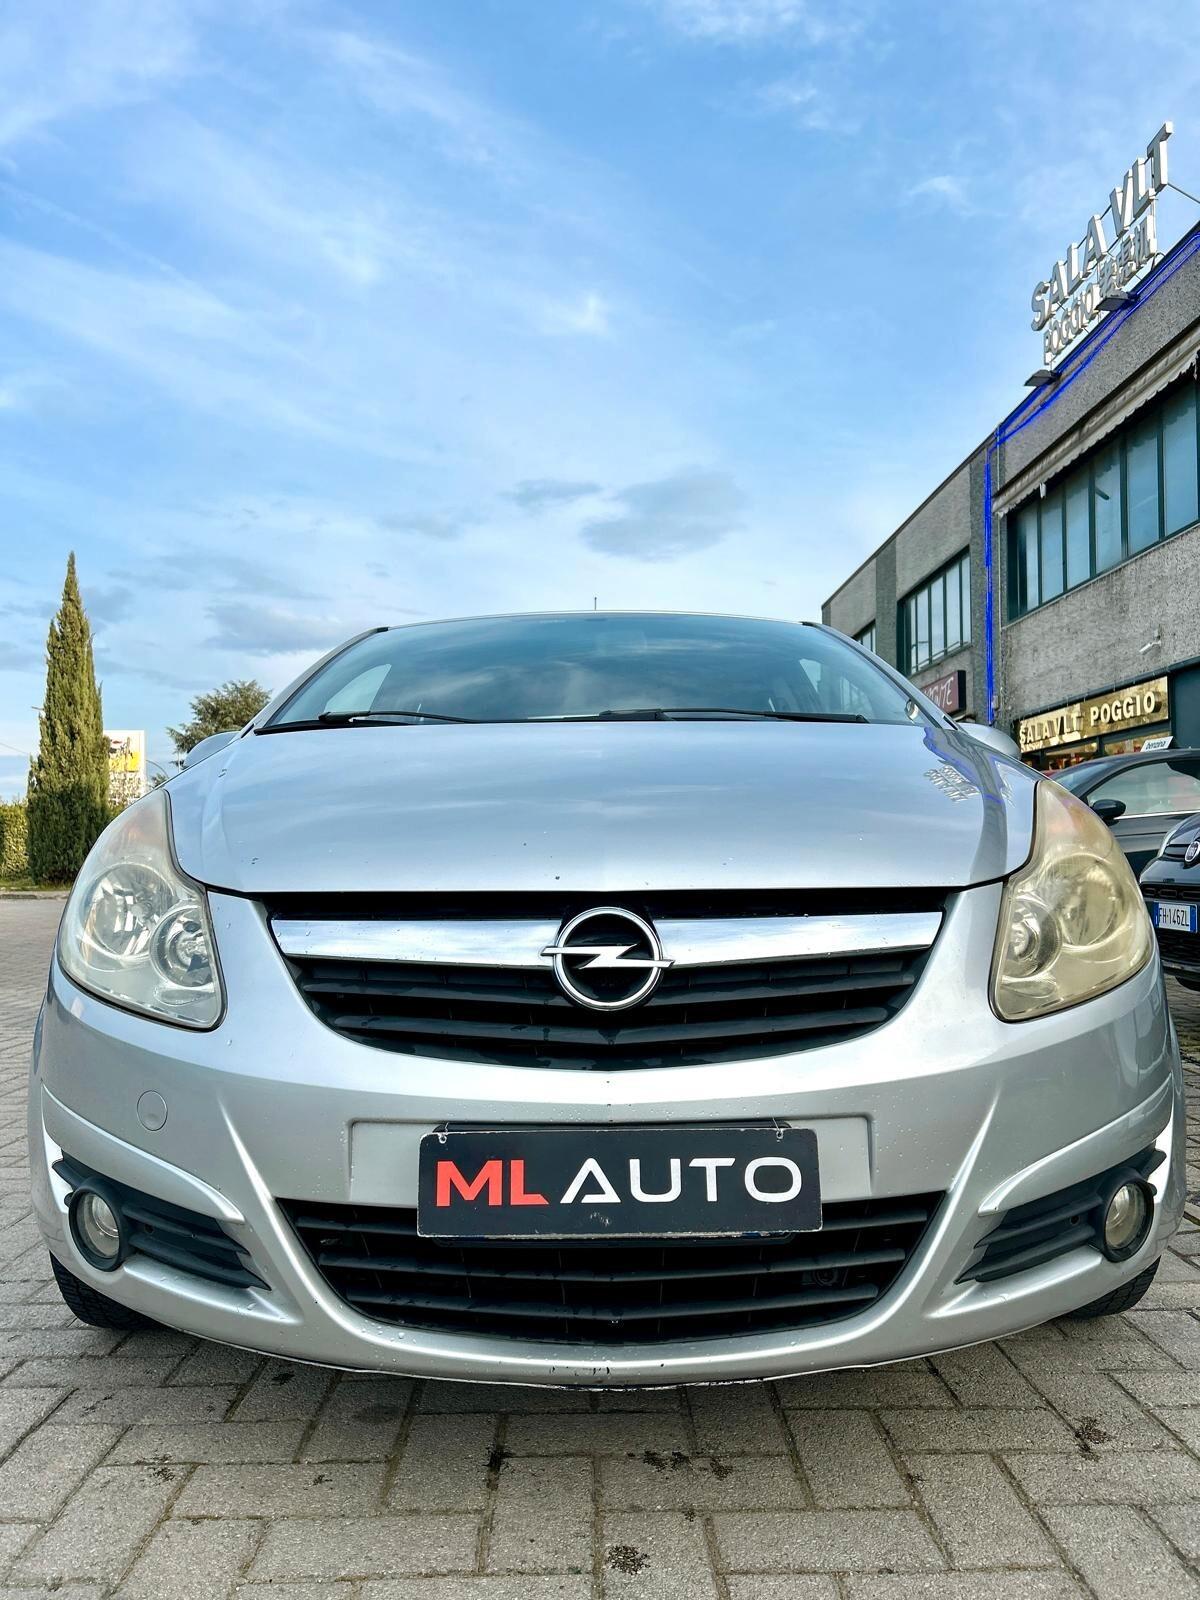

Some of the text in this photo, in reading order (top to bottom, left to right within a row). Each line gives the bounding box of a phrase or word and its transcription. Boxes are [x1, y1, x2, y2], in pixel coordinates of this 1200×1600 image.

[1031, 121, 1173, 332] SALA VLT
[1044, 282, 1099, 365] POGGIO
[1090, 691, 1156, 727] POGGIO
[436, 1157, 802, 1207] ML AUTO
